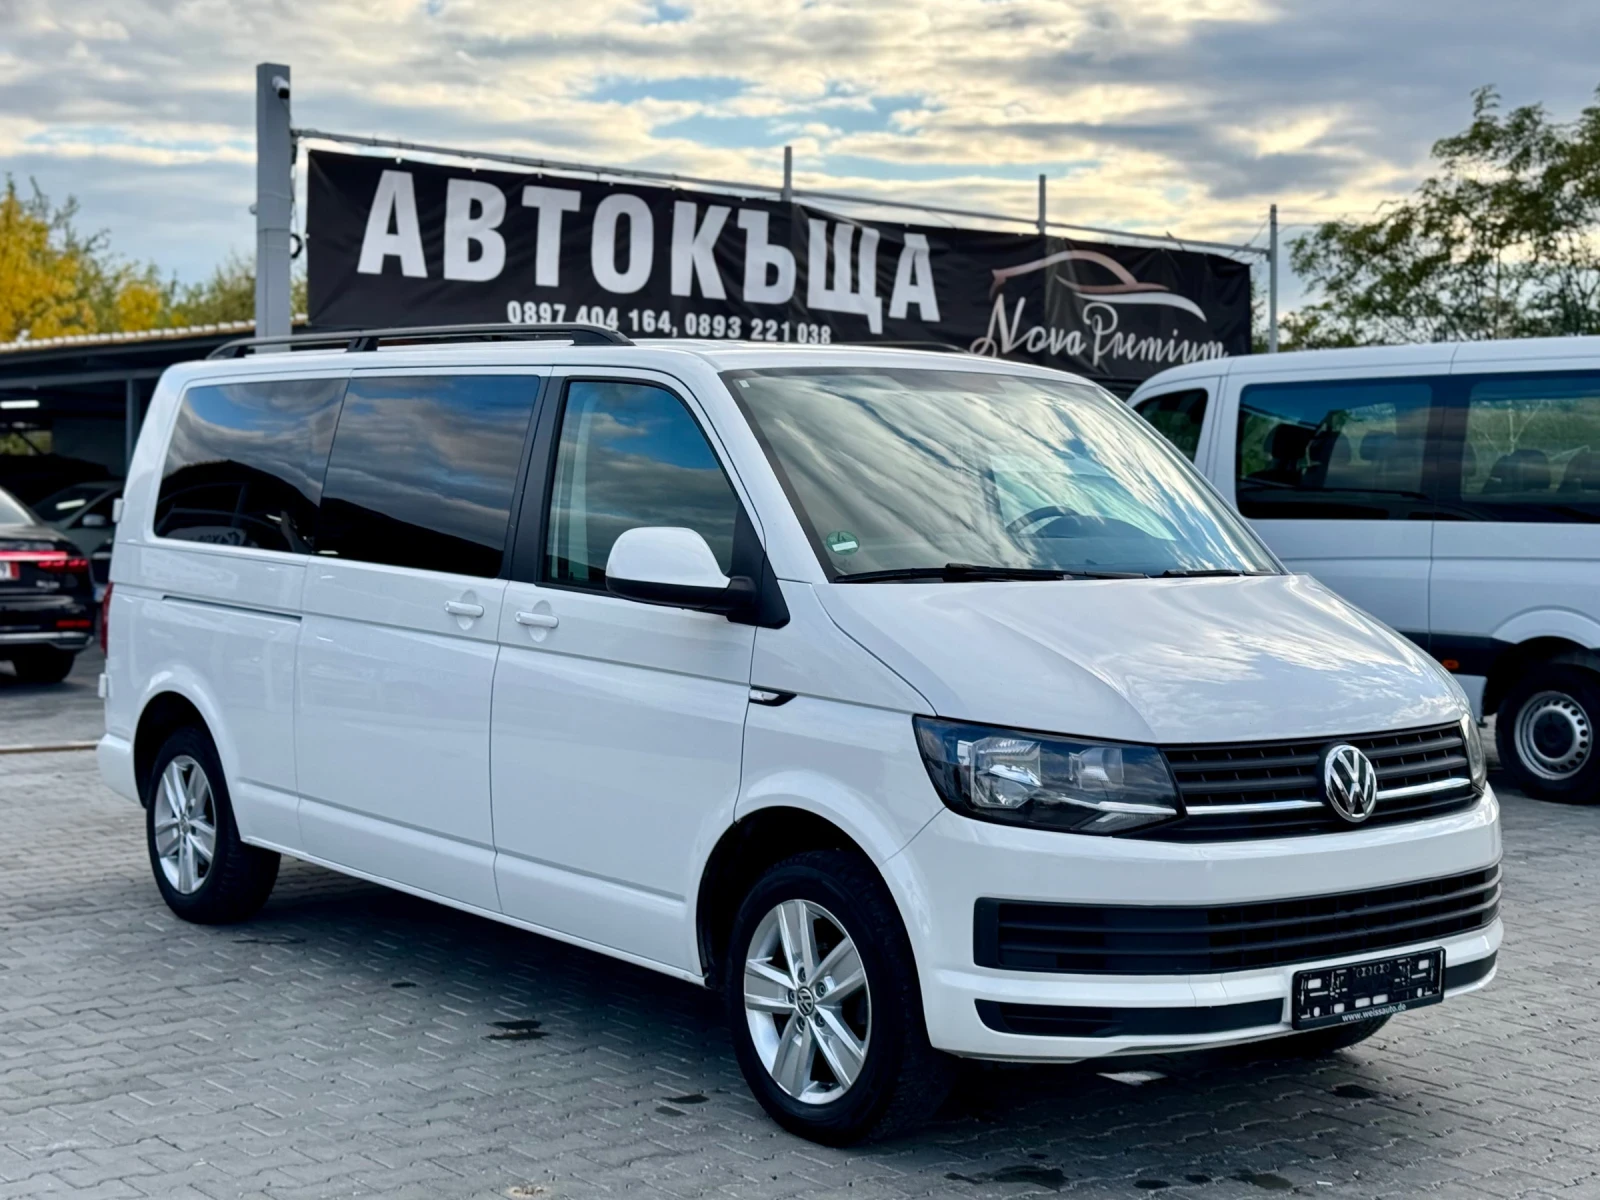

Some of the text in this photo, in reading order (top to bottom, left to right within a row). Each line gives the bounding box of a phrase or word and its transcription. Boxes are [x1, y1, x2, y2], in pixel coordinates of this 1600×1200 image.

[357, 170, 940, 335] АВТОКЪЩА
[507, 300, 832, 344] 0897 404 164, 0893 221 038
[971, 293, 1228, 366] Nova Premium
[1341, 1003, 1407, 1022] www.weissauto.de
